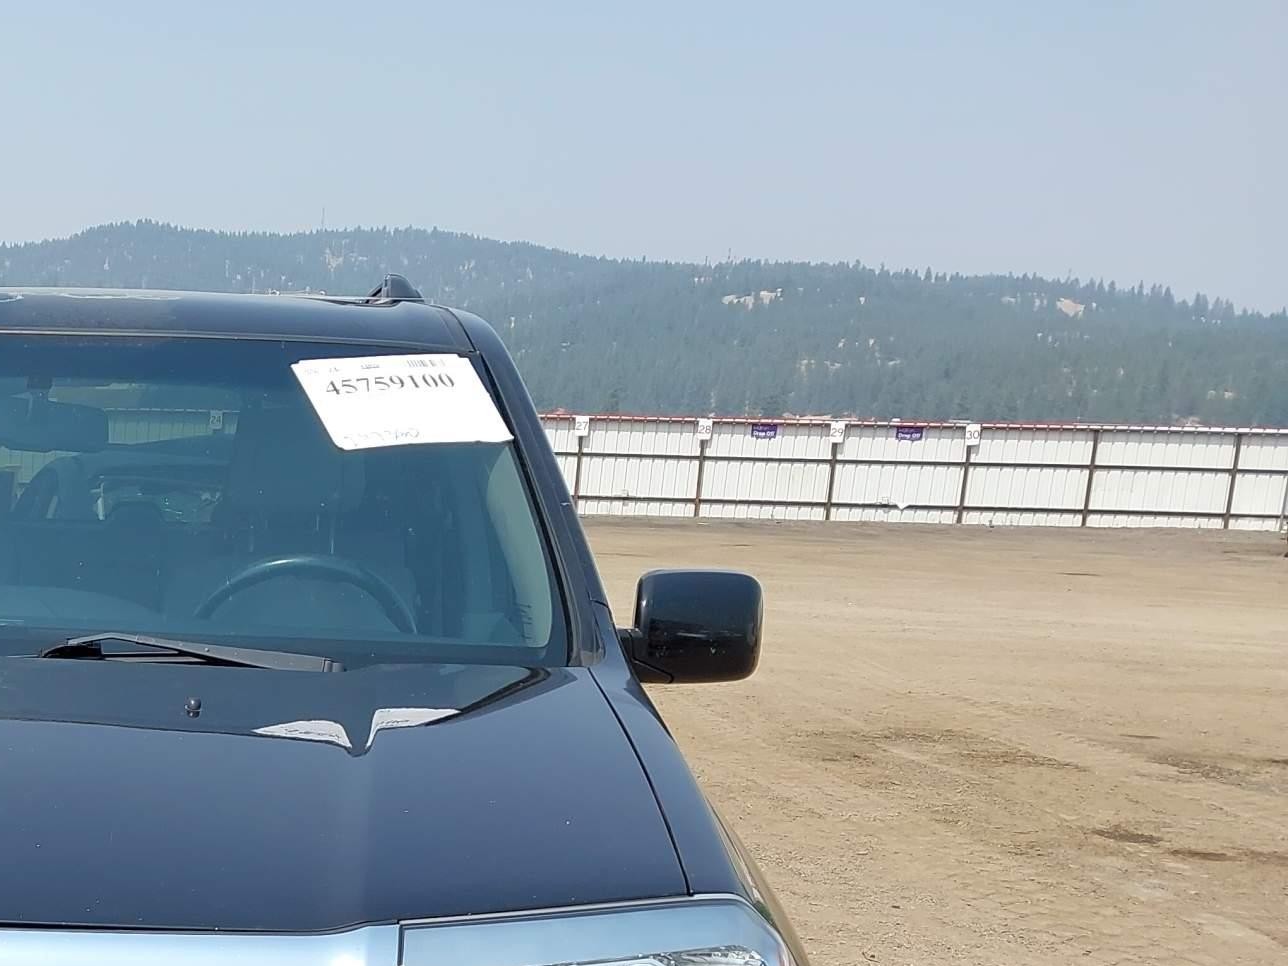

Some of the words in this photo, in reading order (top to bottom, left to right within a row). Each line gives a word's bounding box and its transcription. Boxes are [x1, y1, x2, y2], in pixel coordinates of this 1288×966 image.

[325, 372, 455, 395] 45759100
[211, 415, 222, 425] 24
[575, 421, 589, 431] 27
[698, 425, 712, 434] 28
[831, 427, 844, 438] 29
[966, 430, 980, 440] 30
